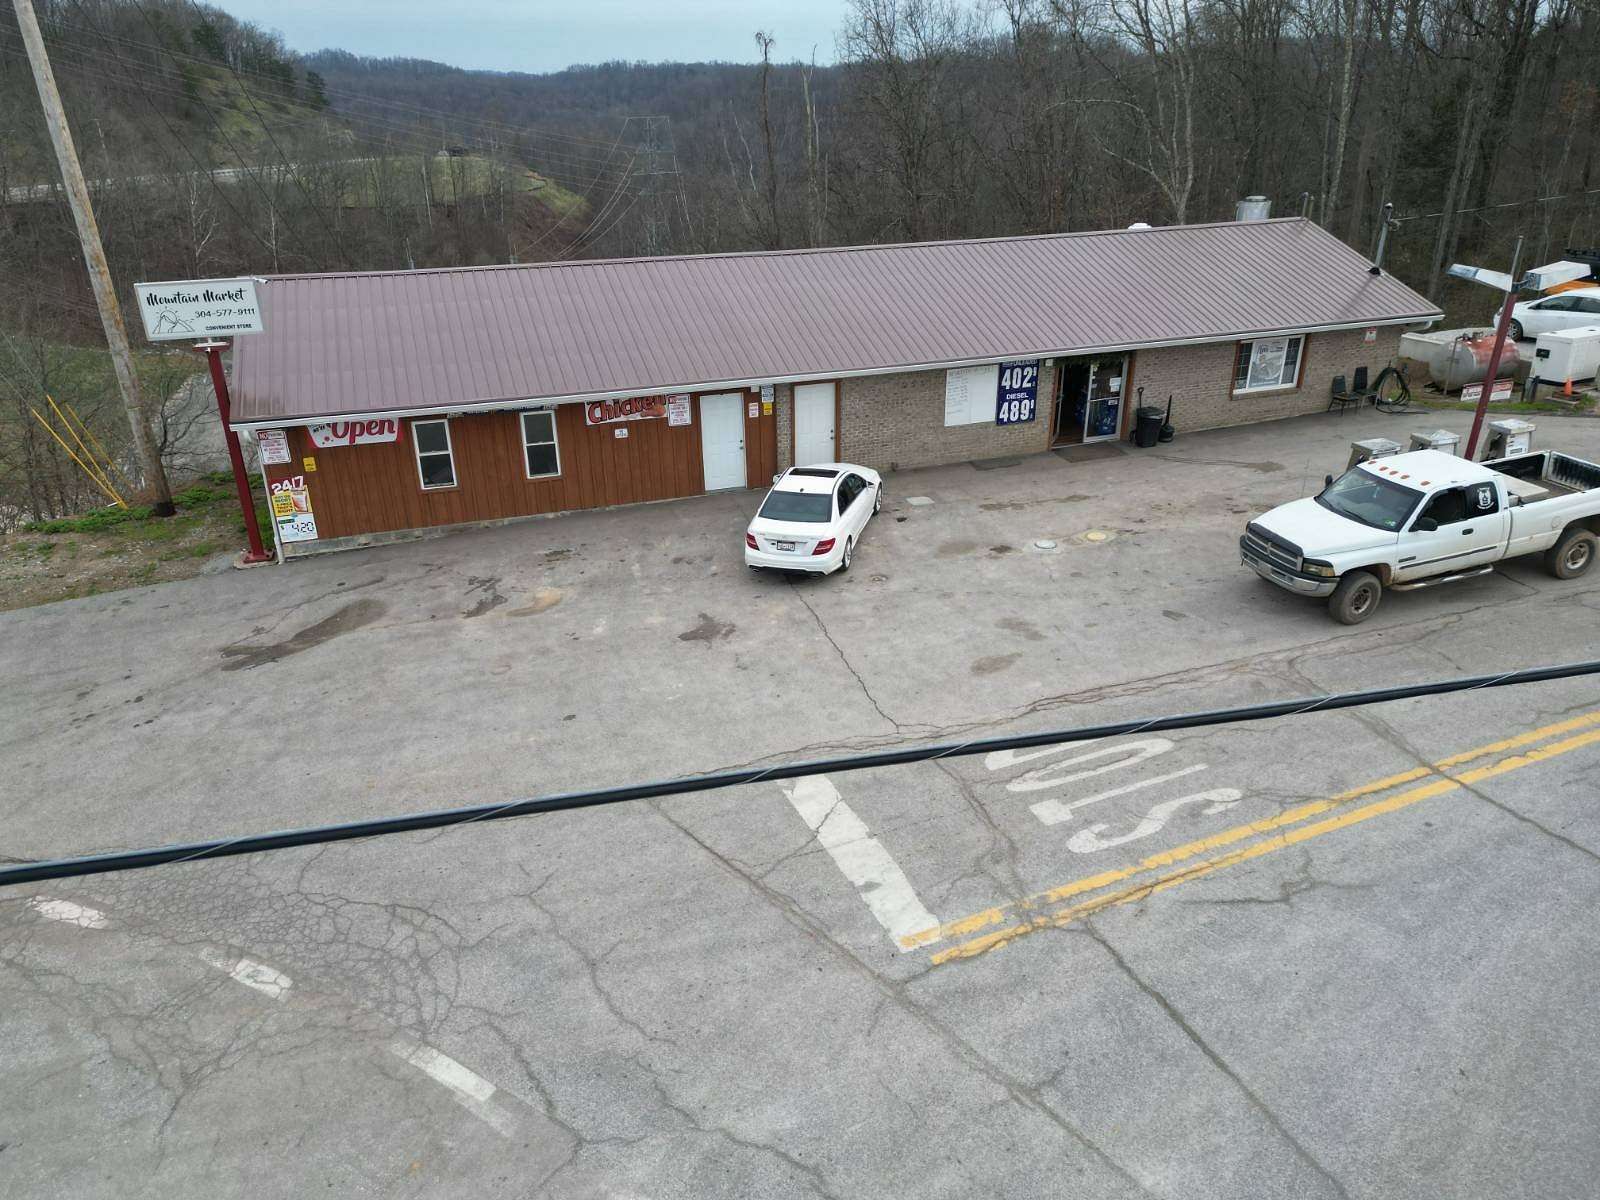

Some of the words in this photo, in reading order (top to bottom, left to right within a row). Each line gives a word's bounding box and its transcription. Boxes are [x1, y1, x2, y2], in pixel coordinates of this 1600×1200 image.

[146, 291, 199, 306] Mountain
[202, 288, 247, 302] Market
[195, 308, 255, 318] 304-577-9111
[1001, 367, 1032, 390] 402
[1006, 392, 1029, 400] DIESEL
[999, 400, 1030, 422] 489
[331, 418, 396, 445] Open
